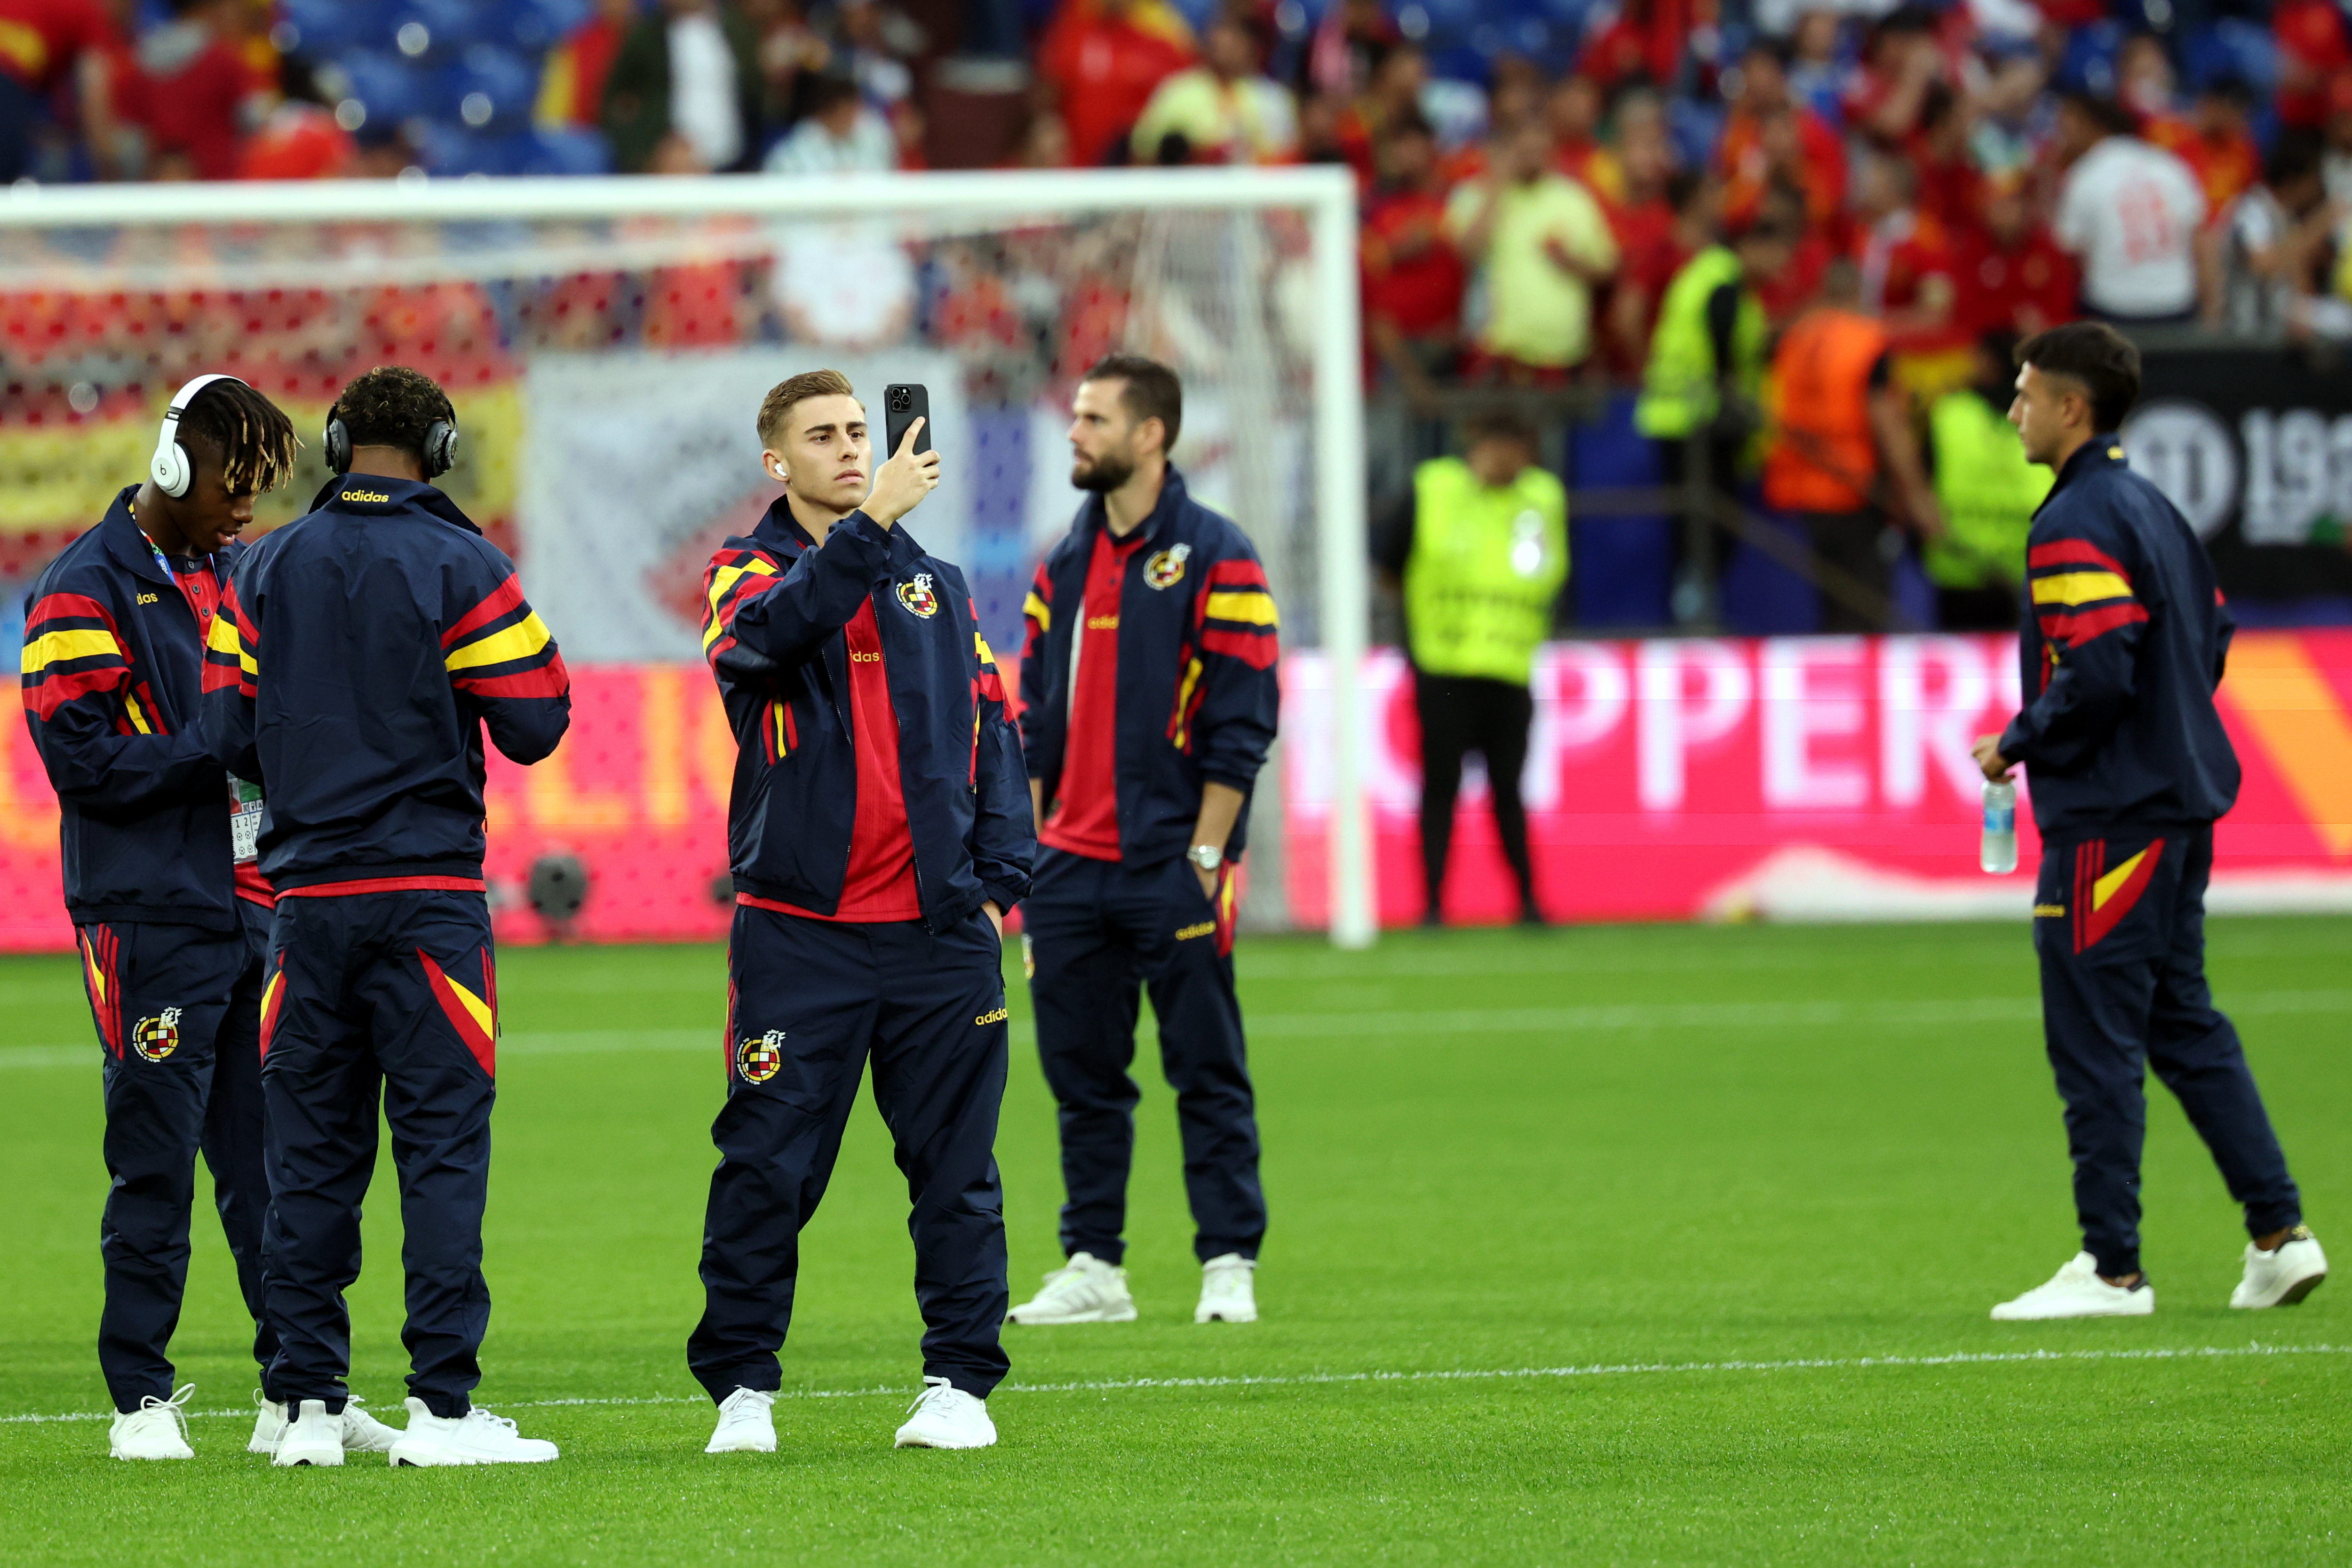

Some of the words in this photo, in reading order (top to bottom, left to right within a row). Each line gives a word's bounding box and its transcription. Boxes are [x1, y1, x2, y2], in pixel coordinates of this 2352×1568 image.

[342, 490, 389, 502] adidas
[137, 593, 158, 605] das
[244, 818, 248, 826] 2
[975, 1008, 1008, 1025] adida
